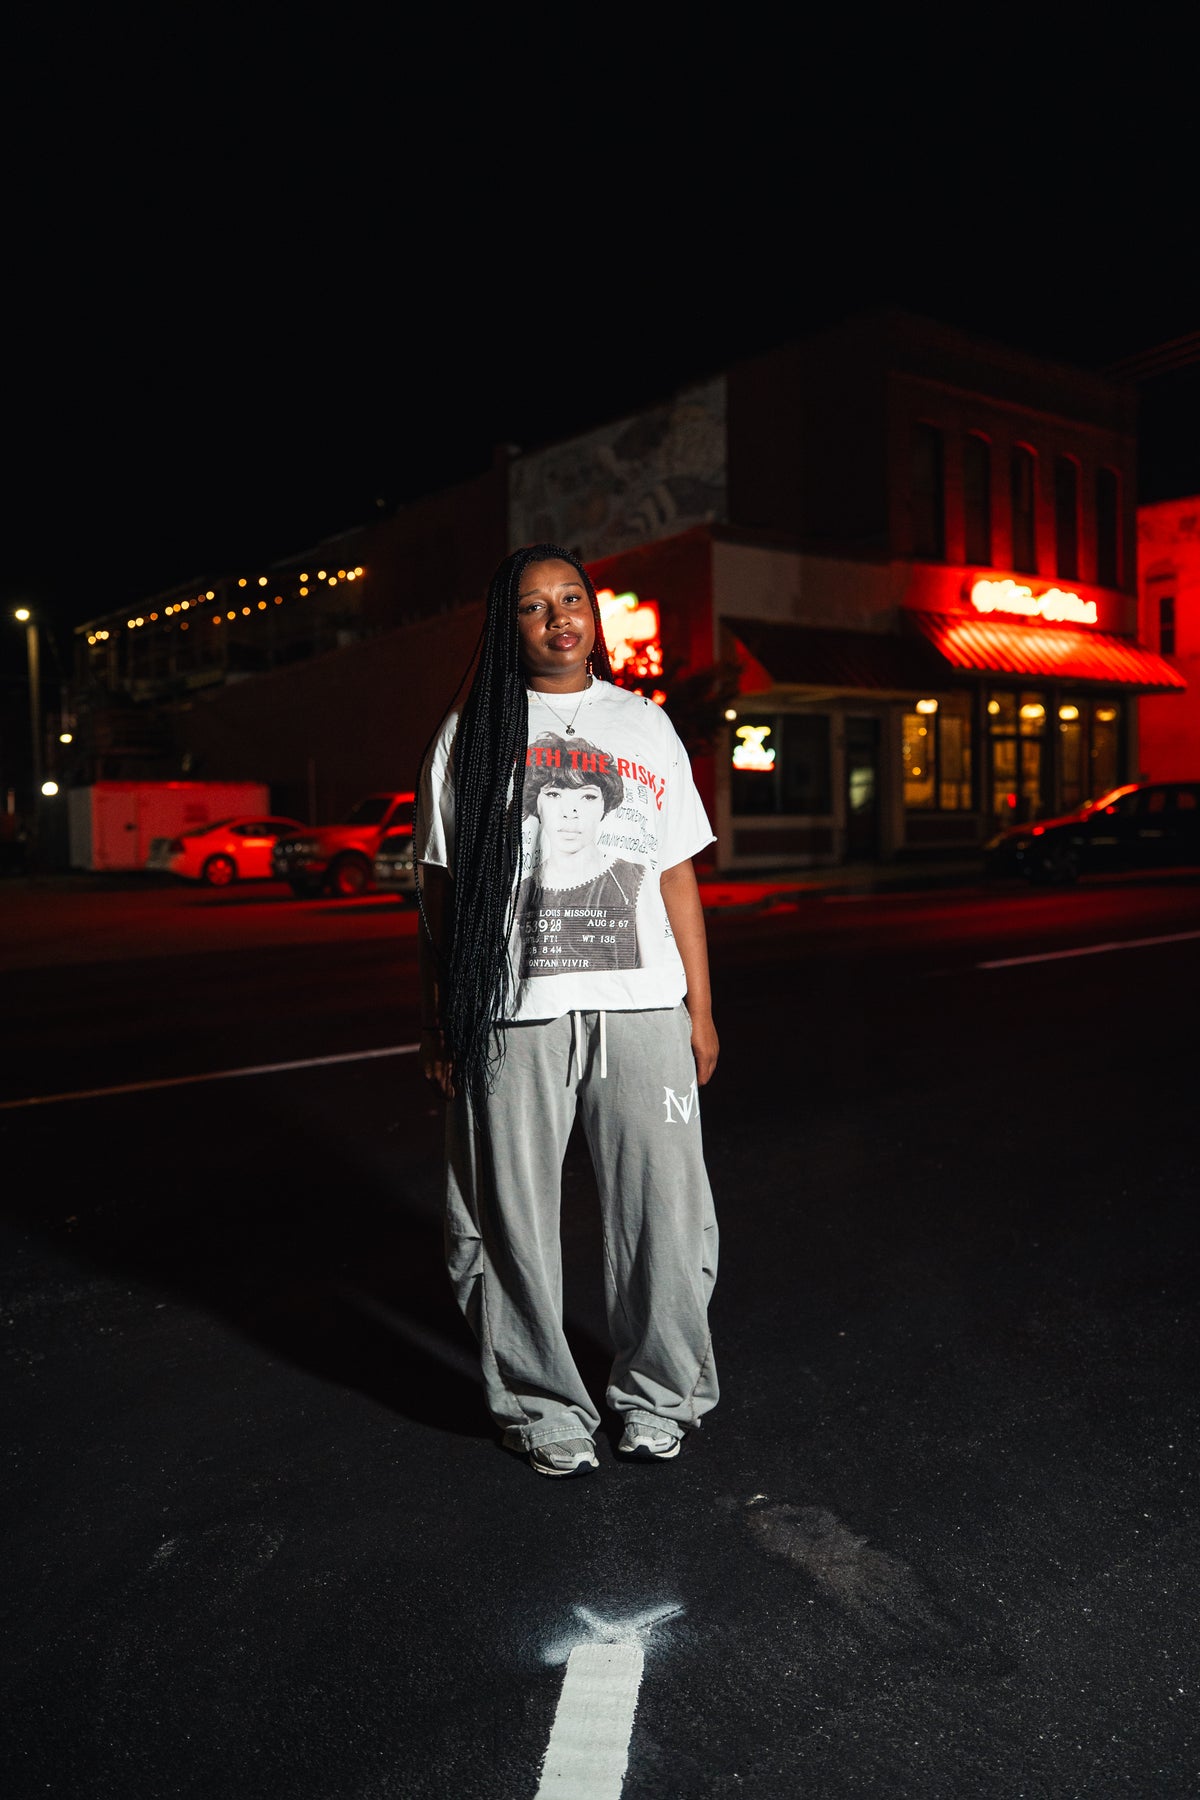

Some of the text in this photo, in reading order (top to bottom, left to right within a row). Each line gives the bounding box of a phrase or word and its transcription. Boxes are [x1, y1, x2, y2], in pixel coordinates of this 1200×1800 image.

[568, 750, 611, 775] THE
[564, 909, 607, 918] MISSOURI
[587, 919, 629, 928] AUG 2 67
[582, 935, 596, 943] WT
[600, 935, 616, 944] 135
[562, 959, 589, 967] VIVIR
